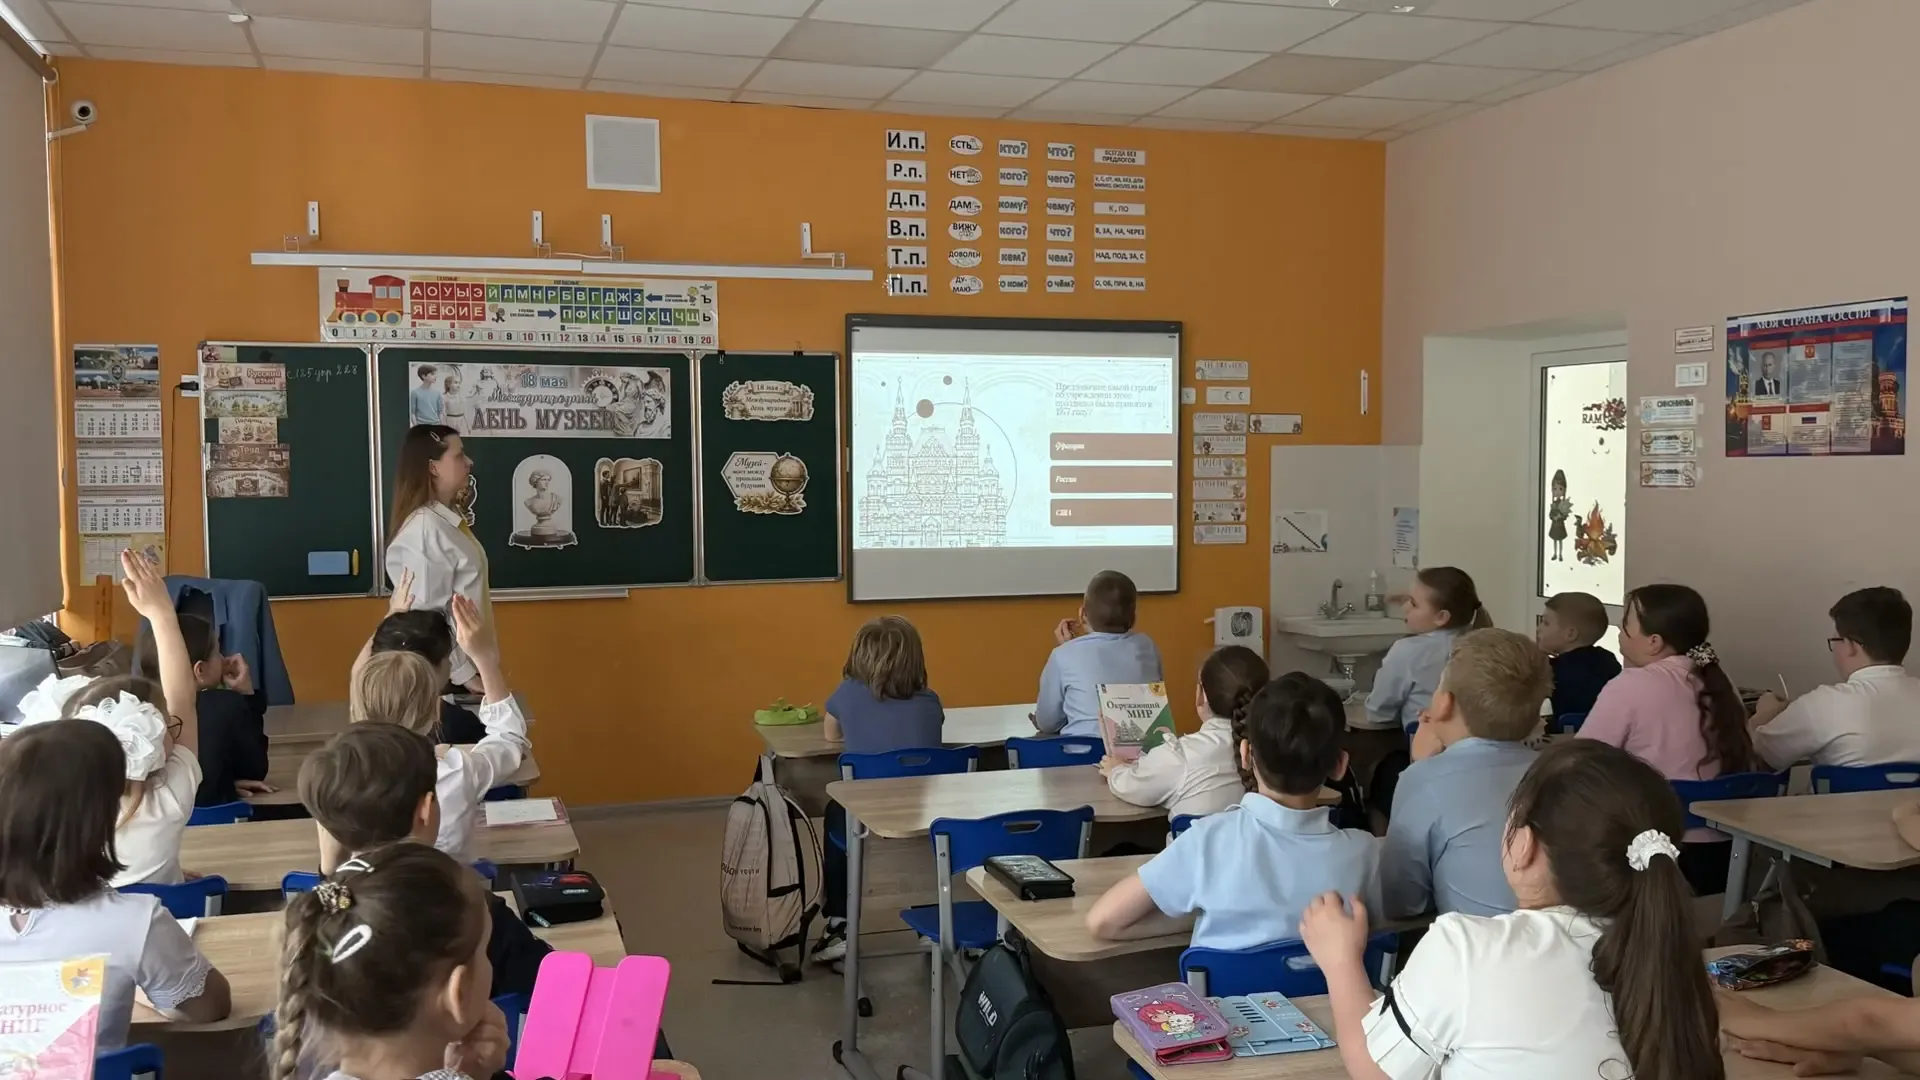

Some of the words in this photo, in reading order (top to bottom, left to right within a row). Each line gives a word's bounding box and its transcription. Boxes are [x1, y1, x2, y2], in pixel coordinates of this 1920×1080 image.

[888, 132, 925, 149] И.п.
[950, 140, 972, 150] ЕСТЬ
[1000, 143, 1027, 155] кто?
[1048, 146, 1075, 157] что?
[894, 163, 922, 178] Р.п.
[950, 170, 967, 179] НЕТ
[1000, 171, 1028, 181] кого?
[1048, 174, 1075, 184] чего?
[890, 192, 925, 209] Д.п.
[950, 200, 972, 209] ДАМ
[999, 200, 1028, 211] кому?
[1048, 202, 1075, 212] чему?
[890, 220, 925, 237] В.п.
[952, 223, 978, 231] ВИЖУ
[1000, 226, 1027, 236] кого?
[1050, 228, 1072, 237] что?
[891, 248, 926, 265] Т.п.
[1002, 252, 1026, 262] кем?
[1048, 253, 1073, 263] чем?
[891, 277, 927, 293] П.п.
[1756, 320, 1779, 329] МОЯ
[1782, 316, 1823, 327] СТРАНА
[1828, 310, 1871, 322] РОССИЯ
[332, 329, 338, 337] 0
[392, 330, 397, 338] 3
[450, 331, 456, 339] 6
[468, 332, 474, 340] 7
[488, 332, 493, 340] 8
[523, 332, 534, 341] 10
[560, 334, 570, 342] 12
[578, 334, 588, 342] 13
[596, 334, 606, 342] 14
[614, 335, 624, 343] 15
[666, 336, 677, 344] 18
[684, 336, 694, 344] 19
[701, 336, 711, 344] 20
[247, 368, 281, 378] Русский
[520, 372, 537, 388] 18
[541, 375, 567, 388] мая
[472, 408, 527, 430] ДЕНЬ
[535, 408, 614, 430] МУЗЕЕВ
[239, 446, 260, 455] Труд
[735, 457, 762, 469] Музей
[1106, 700, 1160, 710] Окружающий
[1127, 710, 1153, 718] МИР
[978, 990, 998, 1027] WILD
